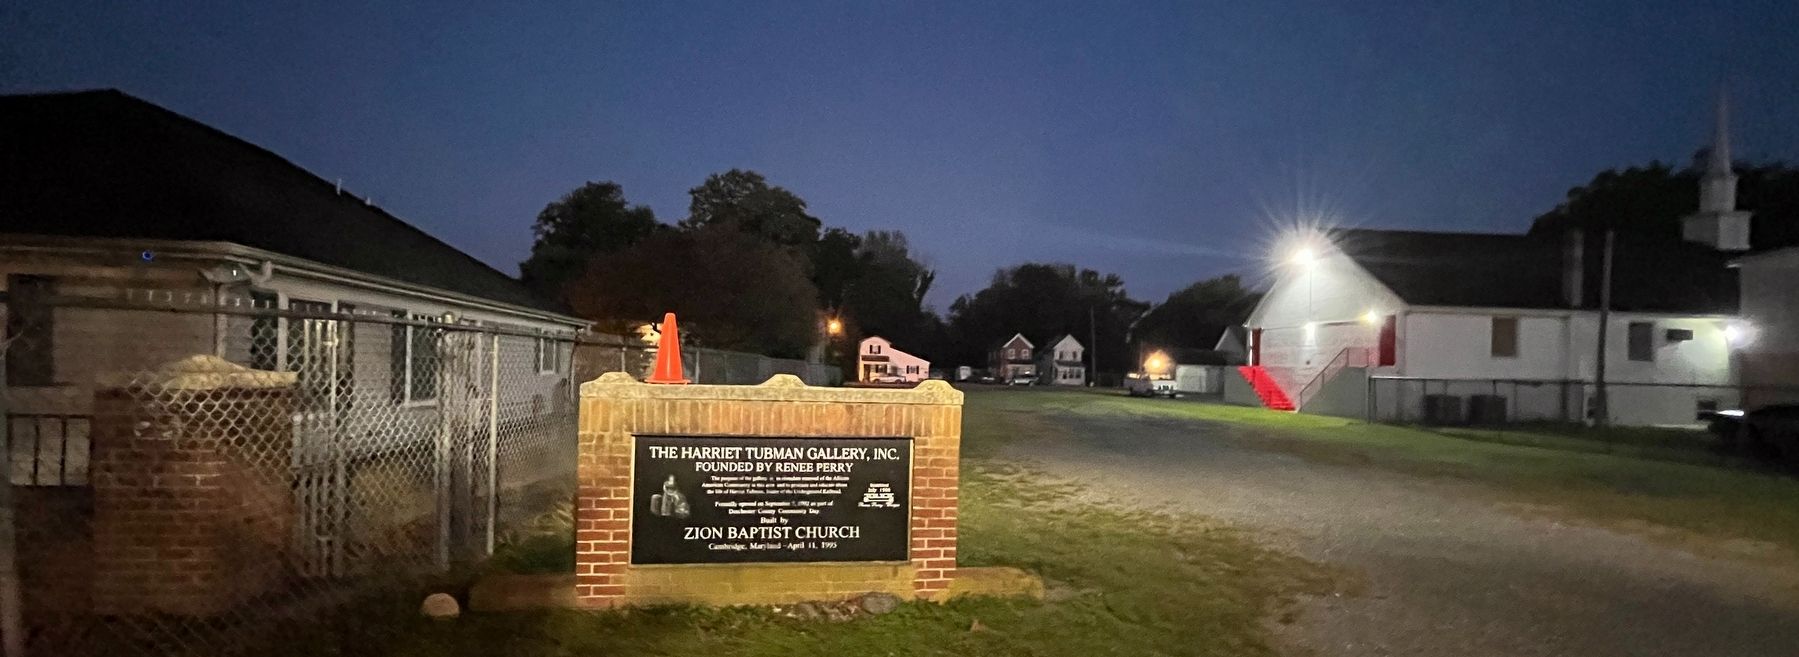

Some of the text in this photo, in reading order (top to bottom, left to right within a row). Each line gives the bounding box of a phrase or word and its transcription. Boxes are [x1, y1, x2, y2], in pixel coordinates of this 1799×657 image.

[649, 446, 900, 461] THE HARRIET TUBMAN GALLERY, INC.
[695, 461, 854, 473] FOUNDED BY RENEE PERRY
[780, 516, 789, 525] by
[684, 526, 860, 540] ZION BAPTIST CHURCH
[749, 542, 781, 550] Maryland
[787, 542, 805, 551] April
